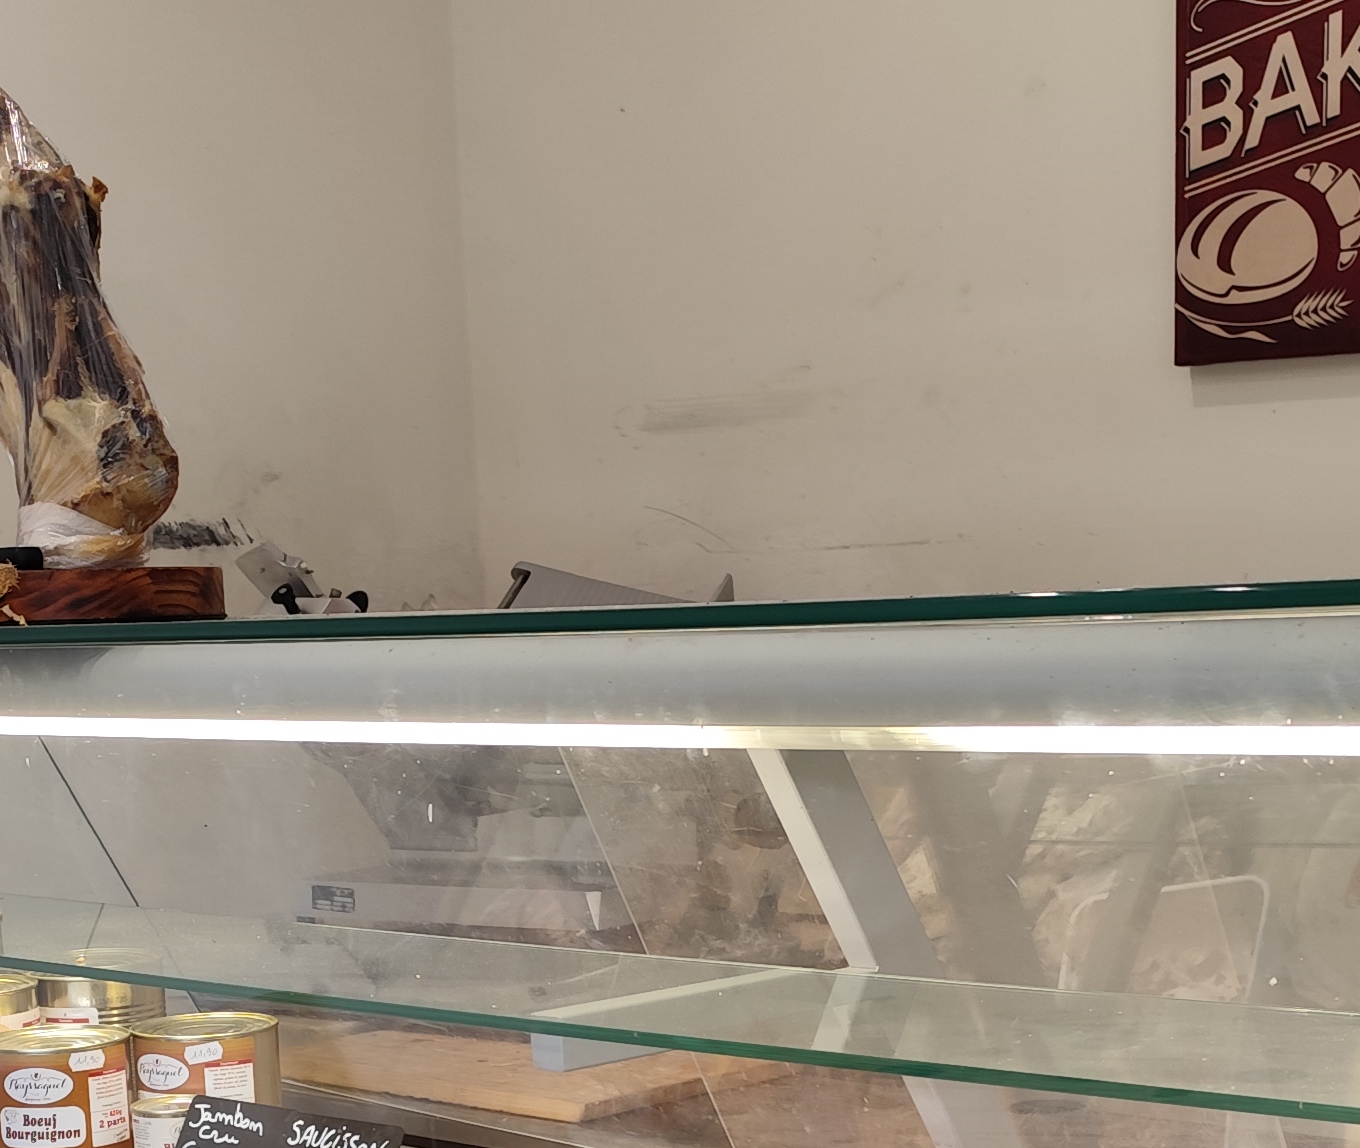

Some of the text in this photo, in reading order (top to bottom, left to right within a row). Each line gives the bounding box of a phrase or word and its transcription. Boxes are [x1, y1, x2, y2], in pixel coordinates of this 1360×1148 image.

[22, 1114, 57, 1129] Boeuf
[99, 1116, 126, 1129] 2 parts
[5, 1127, 81, 1143] Bourguignon
[198, 1125, 239, 1145] Cru
